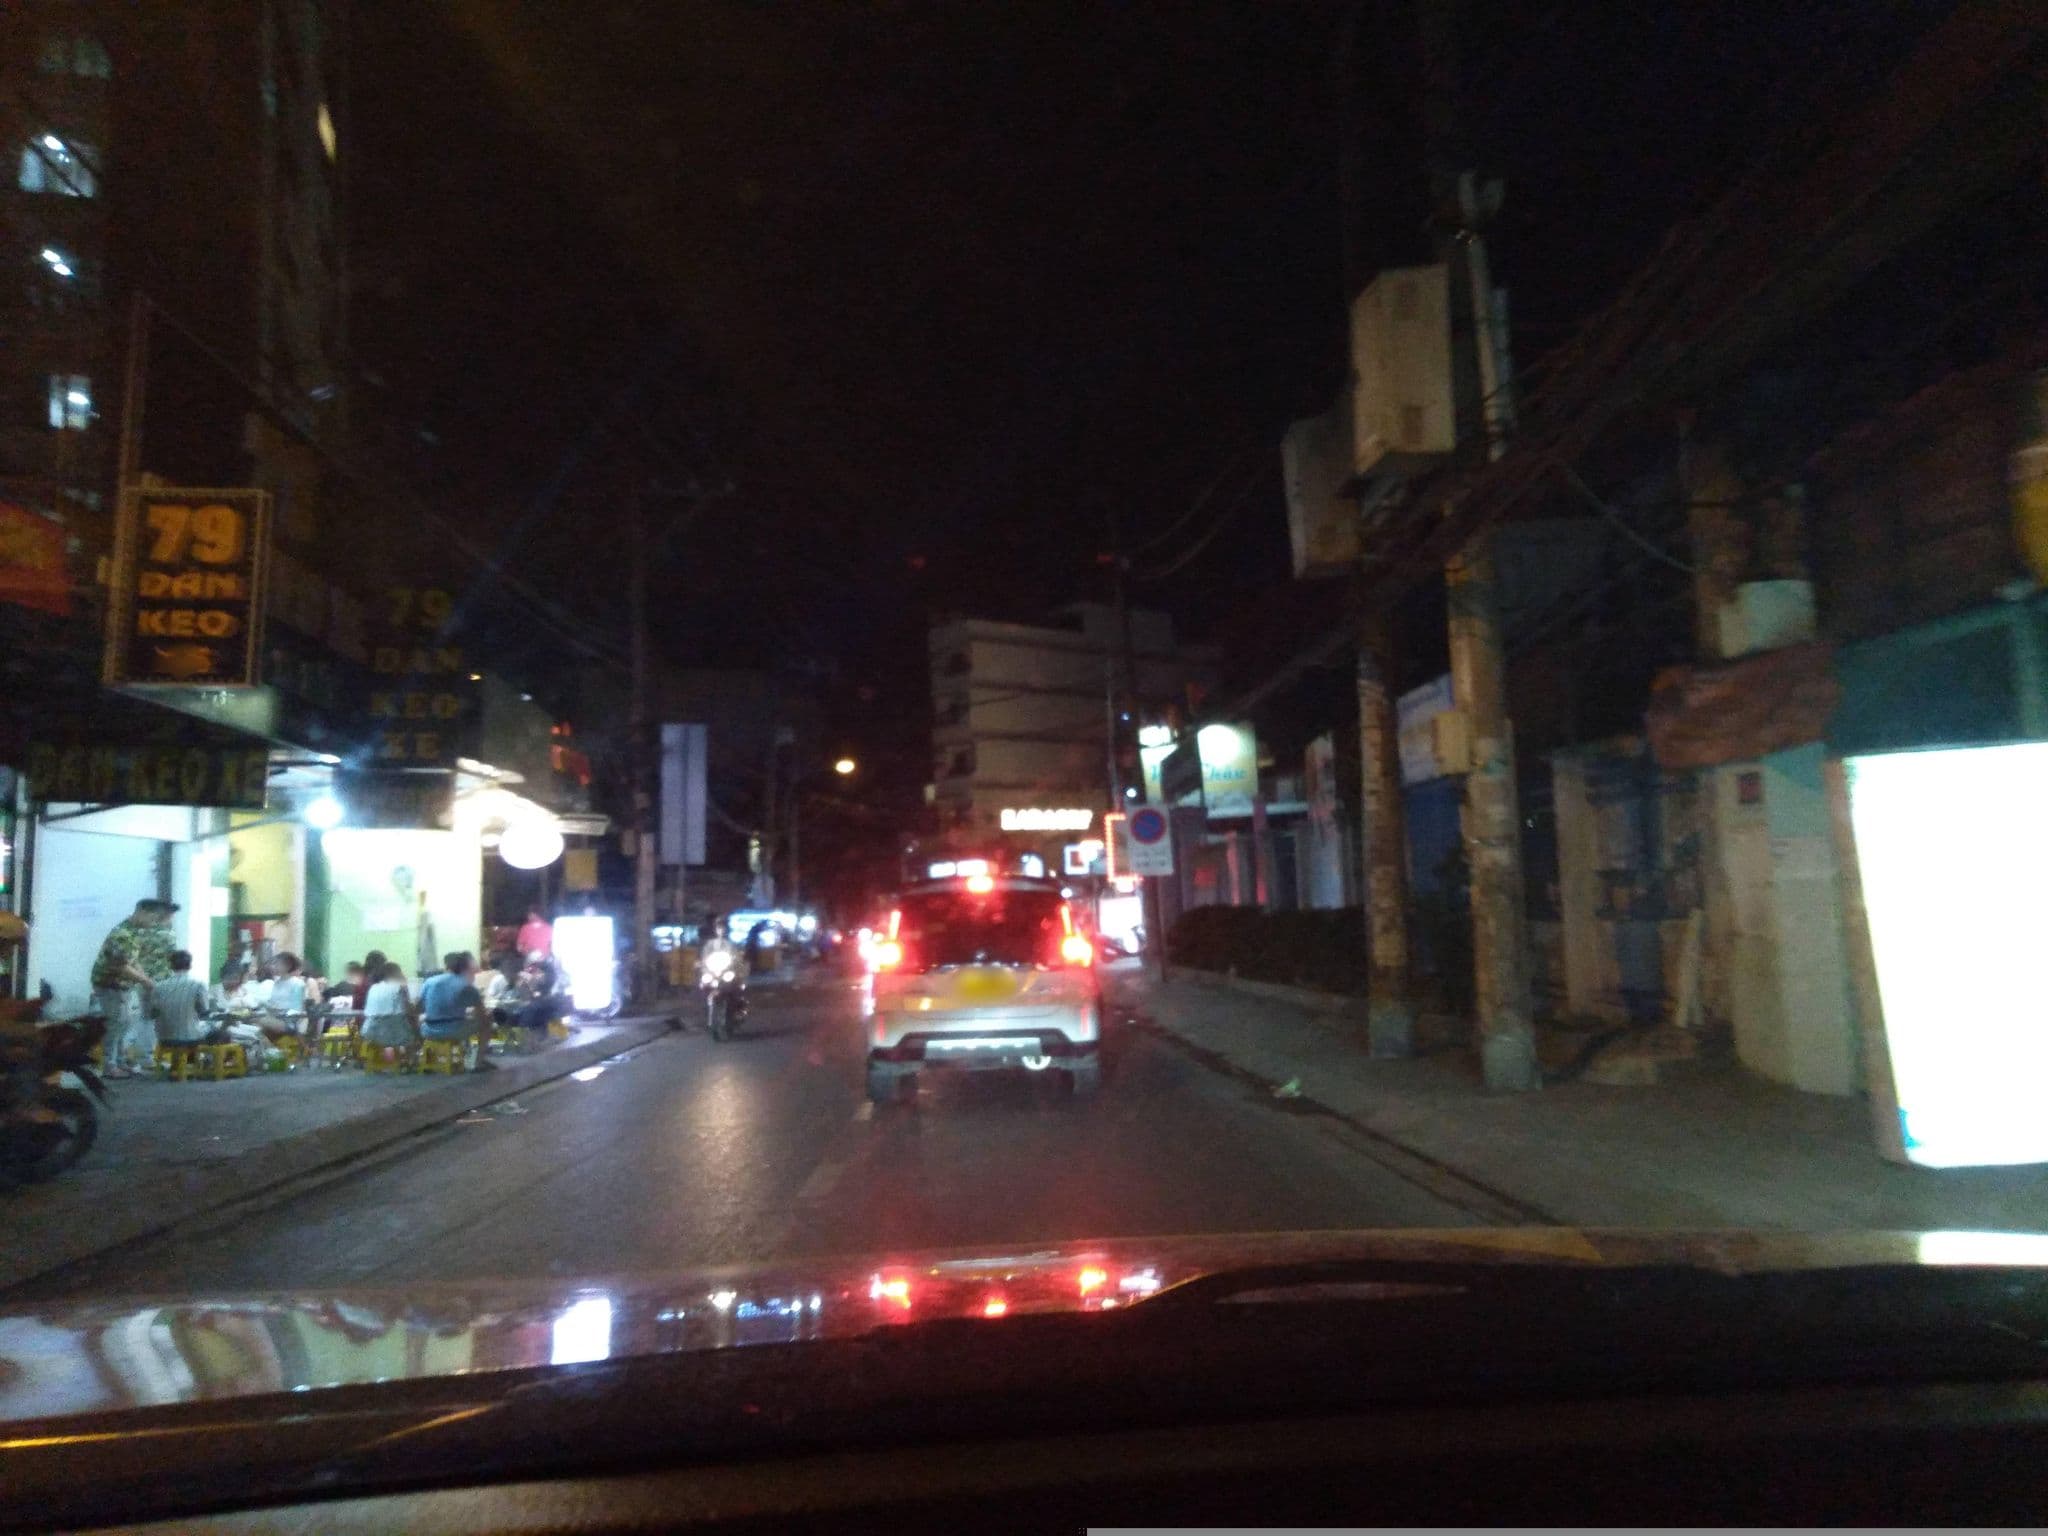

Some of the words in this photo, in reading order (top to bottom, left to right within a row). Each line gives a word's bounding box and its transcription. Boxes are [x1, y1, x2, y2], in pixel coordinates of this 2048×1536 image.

[147, 504, 245, 564] 79
[138, 609, 238, 637] KEO
[385, 586, 450, 629] 79
